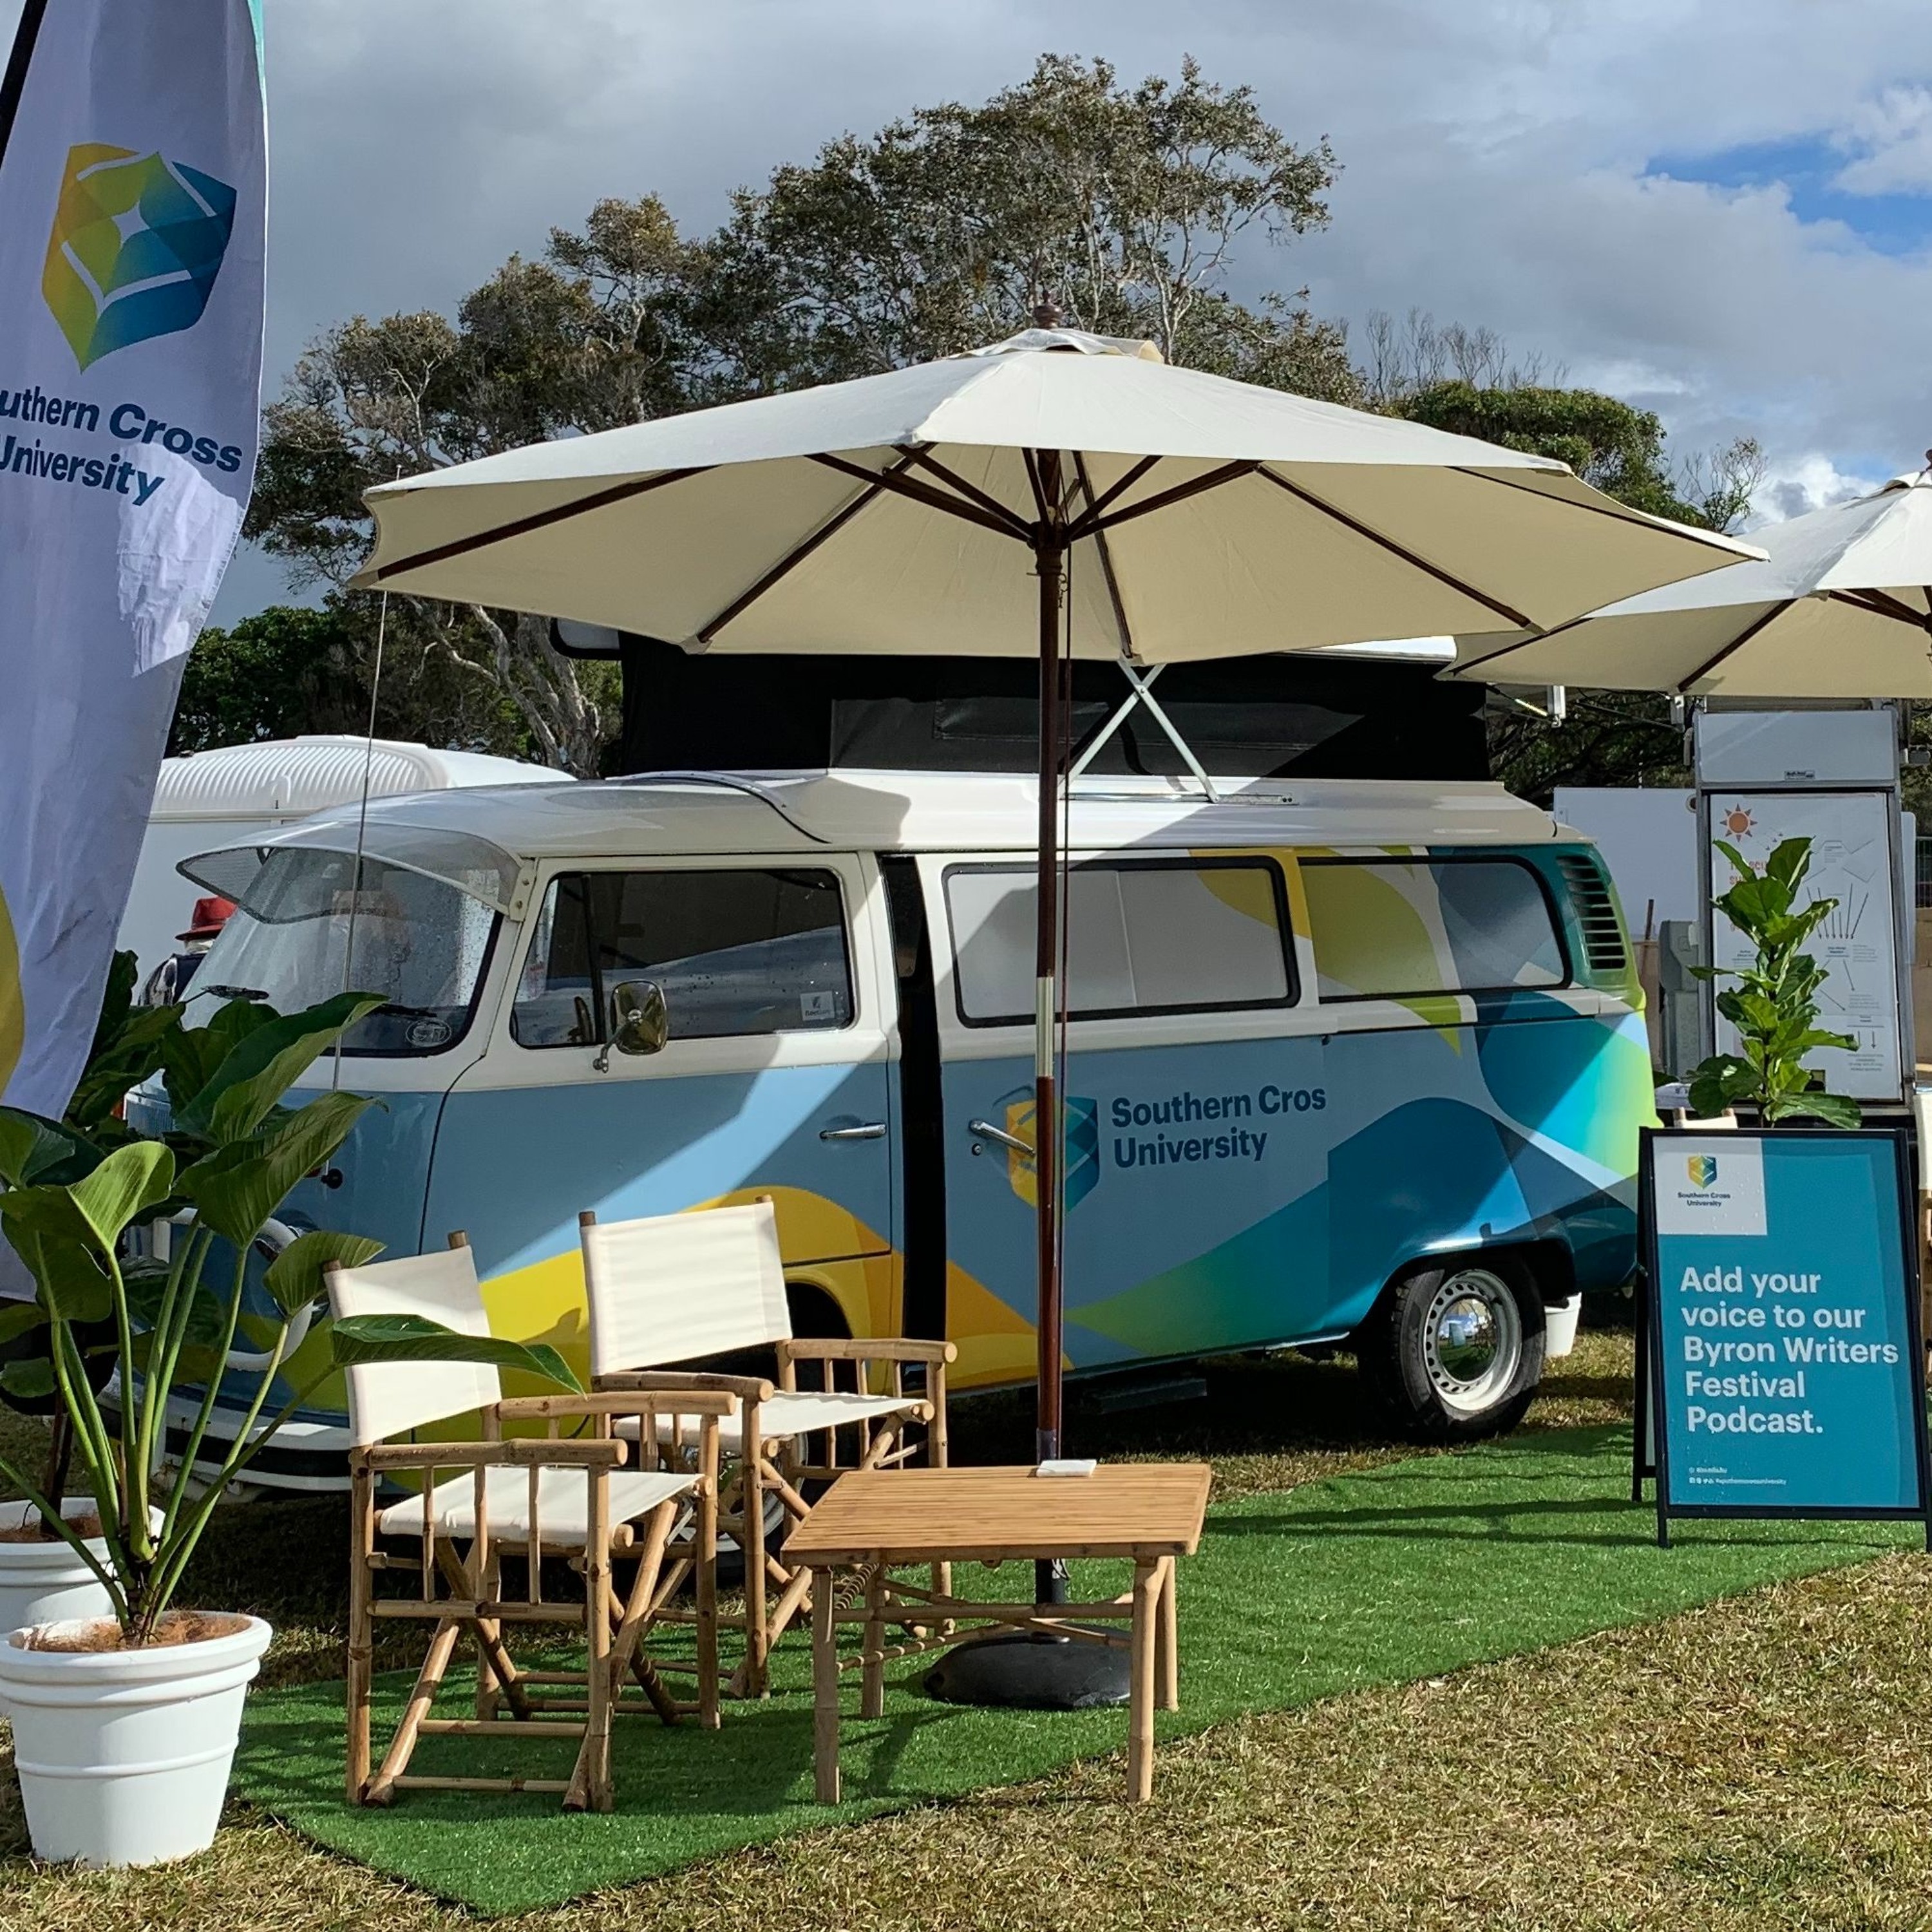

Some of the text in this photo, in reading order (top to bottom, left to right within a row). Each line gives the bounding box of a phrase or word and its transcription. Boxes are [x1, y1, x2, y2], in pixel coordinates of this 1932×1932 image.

[109, 402, 243, 473] Cross
[1111, 1085, 1326, 1128] Southern Cros
[1114, 1127, 1267, 1168] University
[1680, 1265, 1821, 1298] Add your
[1681, 1301, 1866, 1328] voice to our
[1683, 1336, 1899, 1367] Byron Writers
[1685, 1370, 1805, 1397] Festival
[1687, 1406, 1824, 1434] Podcast.
